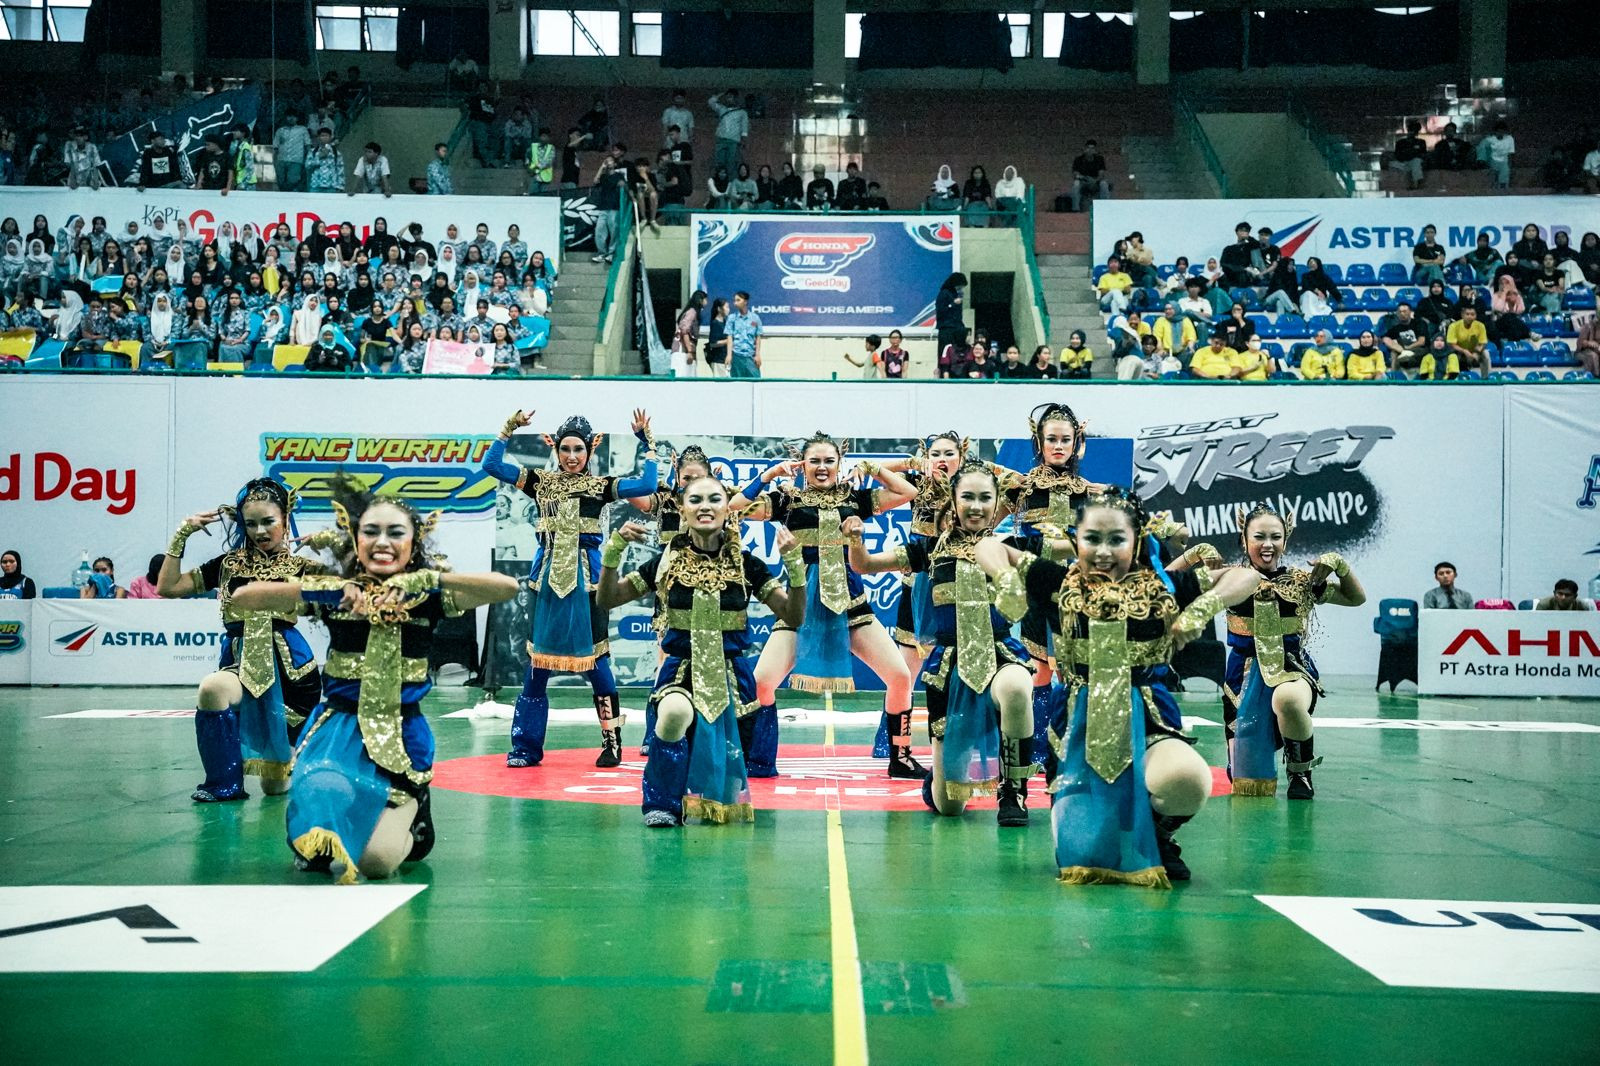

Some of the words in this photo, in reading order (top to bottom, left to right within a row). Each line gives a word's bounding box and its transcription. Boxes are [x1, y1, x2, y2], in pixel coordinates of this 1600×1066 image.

[1449, 226, 1573, 247] MOTR
[803, 242, 850, 250] HONDA
[802, 255, 826, 266] DBL
[752, 306, 791, 314] HOME
[817, 306, 894, 314] DREAMERS
[265, 437, 352, 462] YANG
[355, 438, 471, 463] WORTH
[1134, 425, 1396, 500] STREET
[34, 451, 136, 516] Day
[102, 631, 168, 646] ASTRA
[1440, 662, 1459, 675] PT
[1464, 663, 1509, 676] Astra
[1515, 664, 1571, 677] Honda
